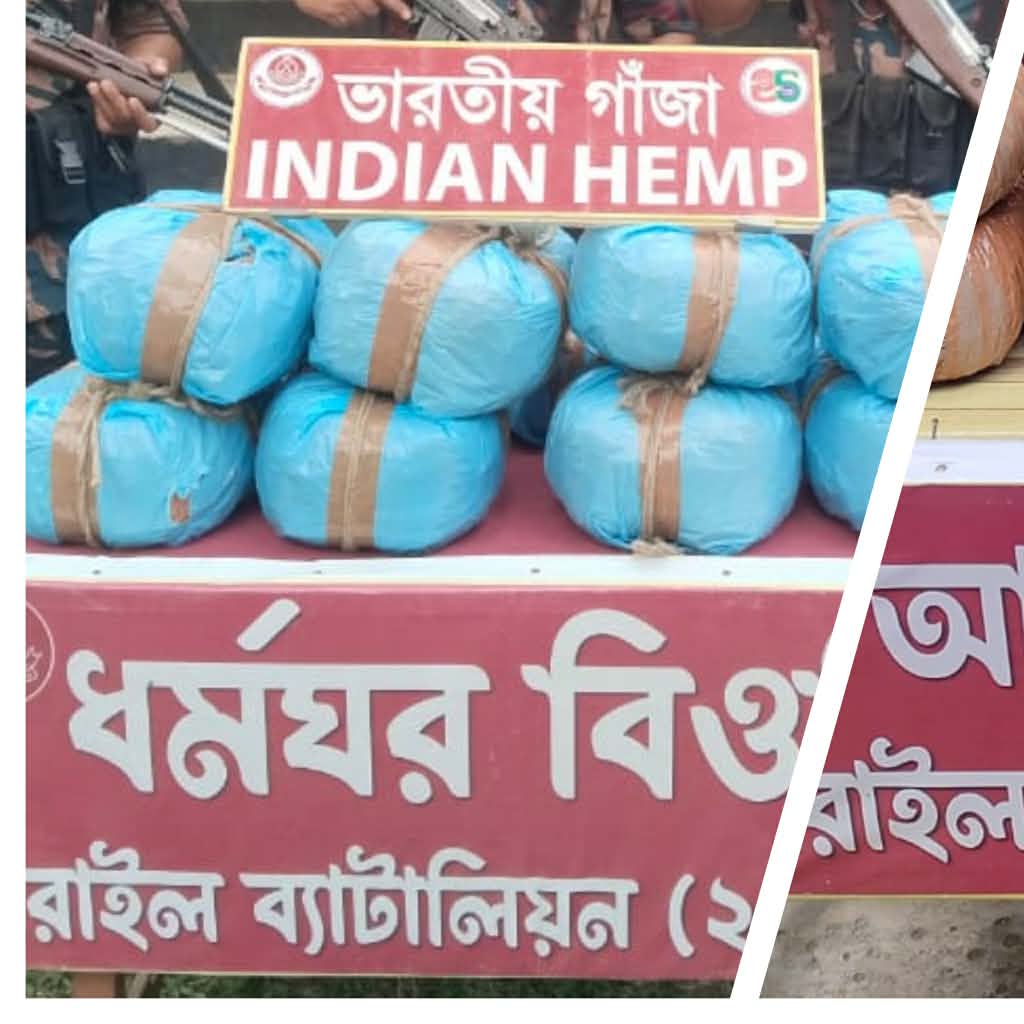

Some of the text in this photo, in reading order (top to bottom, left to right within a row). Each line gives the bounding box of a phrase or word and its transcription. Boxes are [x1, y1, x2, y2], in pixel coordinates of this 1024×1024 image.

[332, 55, 724, 138] ভারতীয় গাঁজা
[244, 137, 809, 209] INDIAN HEMP
[66, 598, 834, 805] ধর্মঘর বিও
[240, 845, 639, 958] ব্যাটালিয়ন
